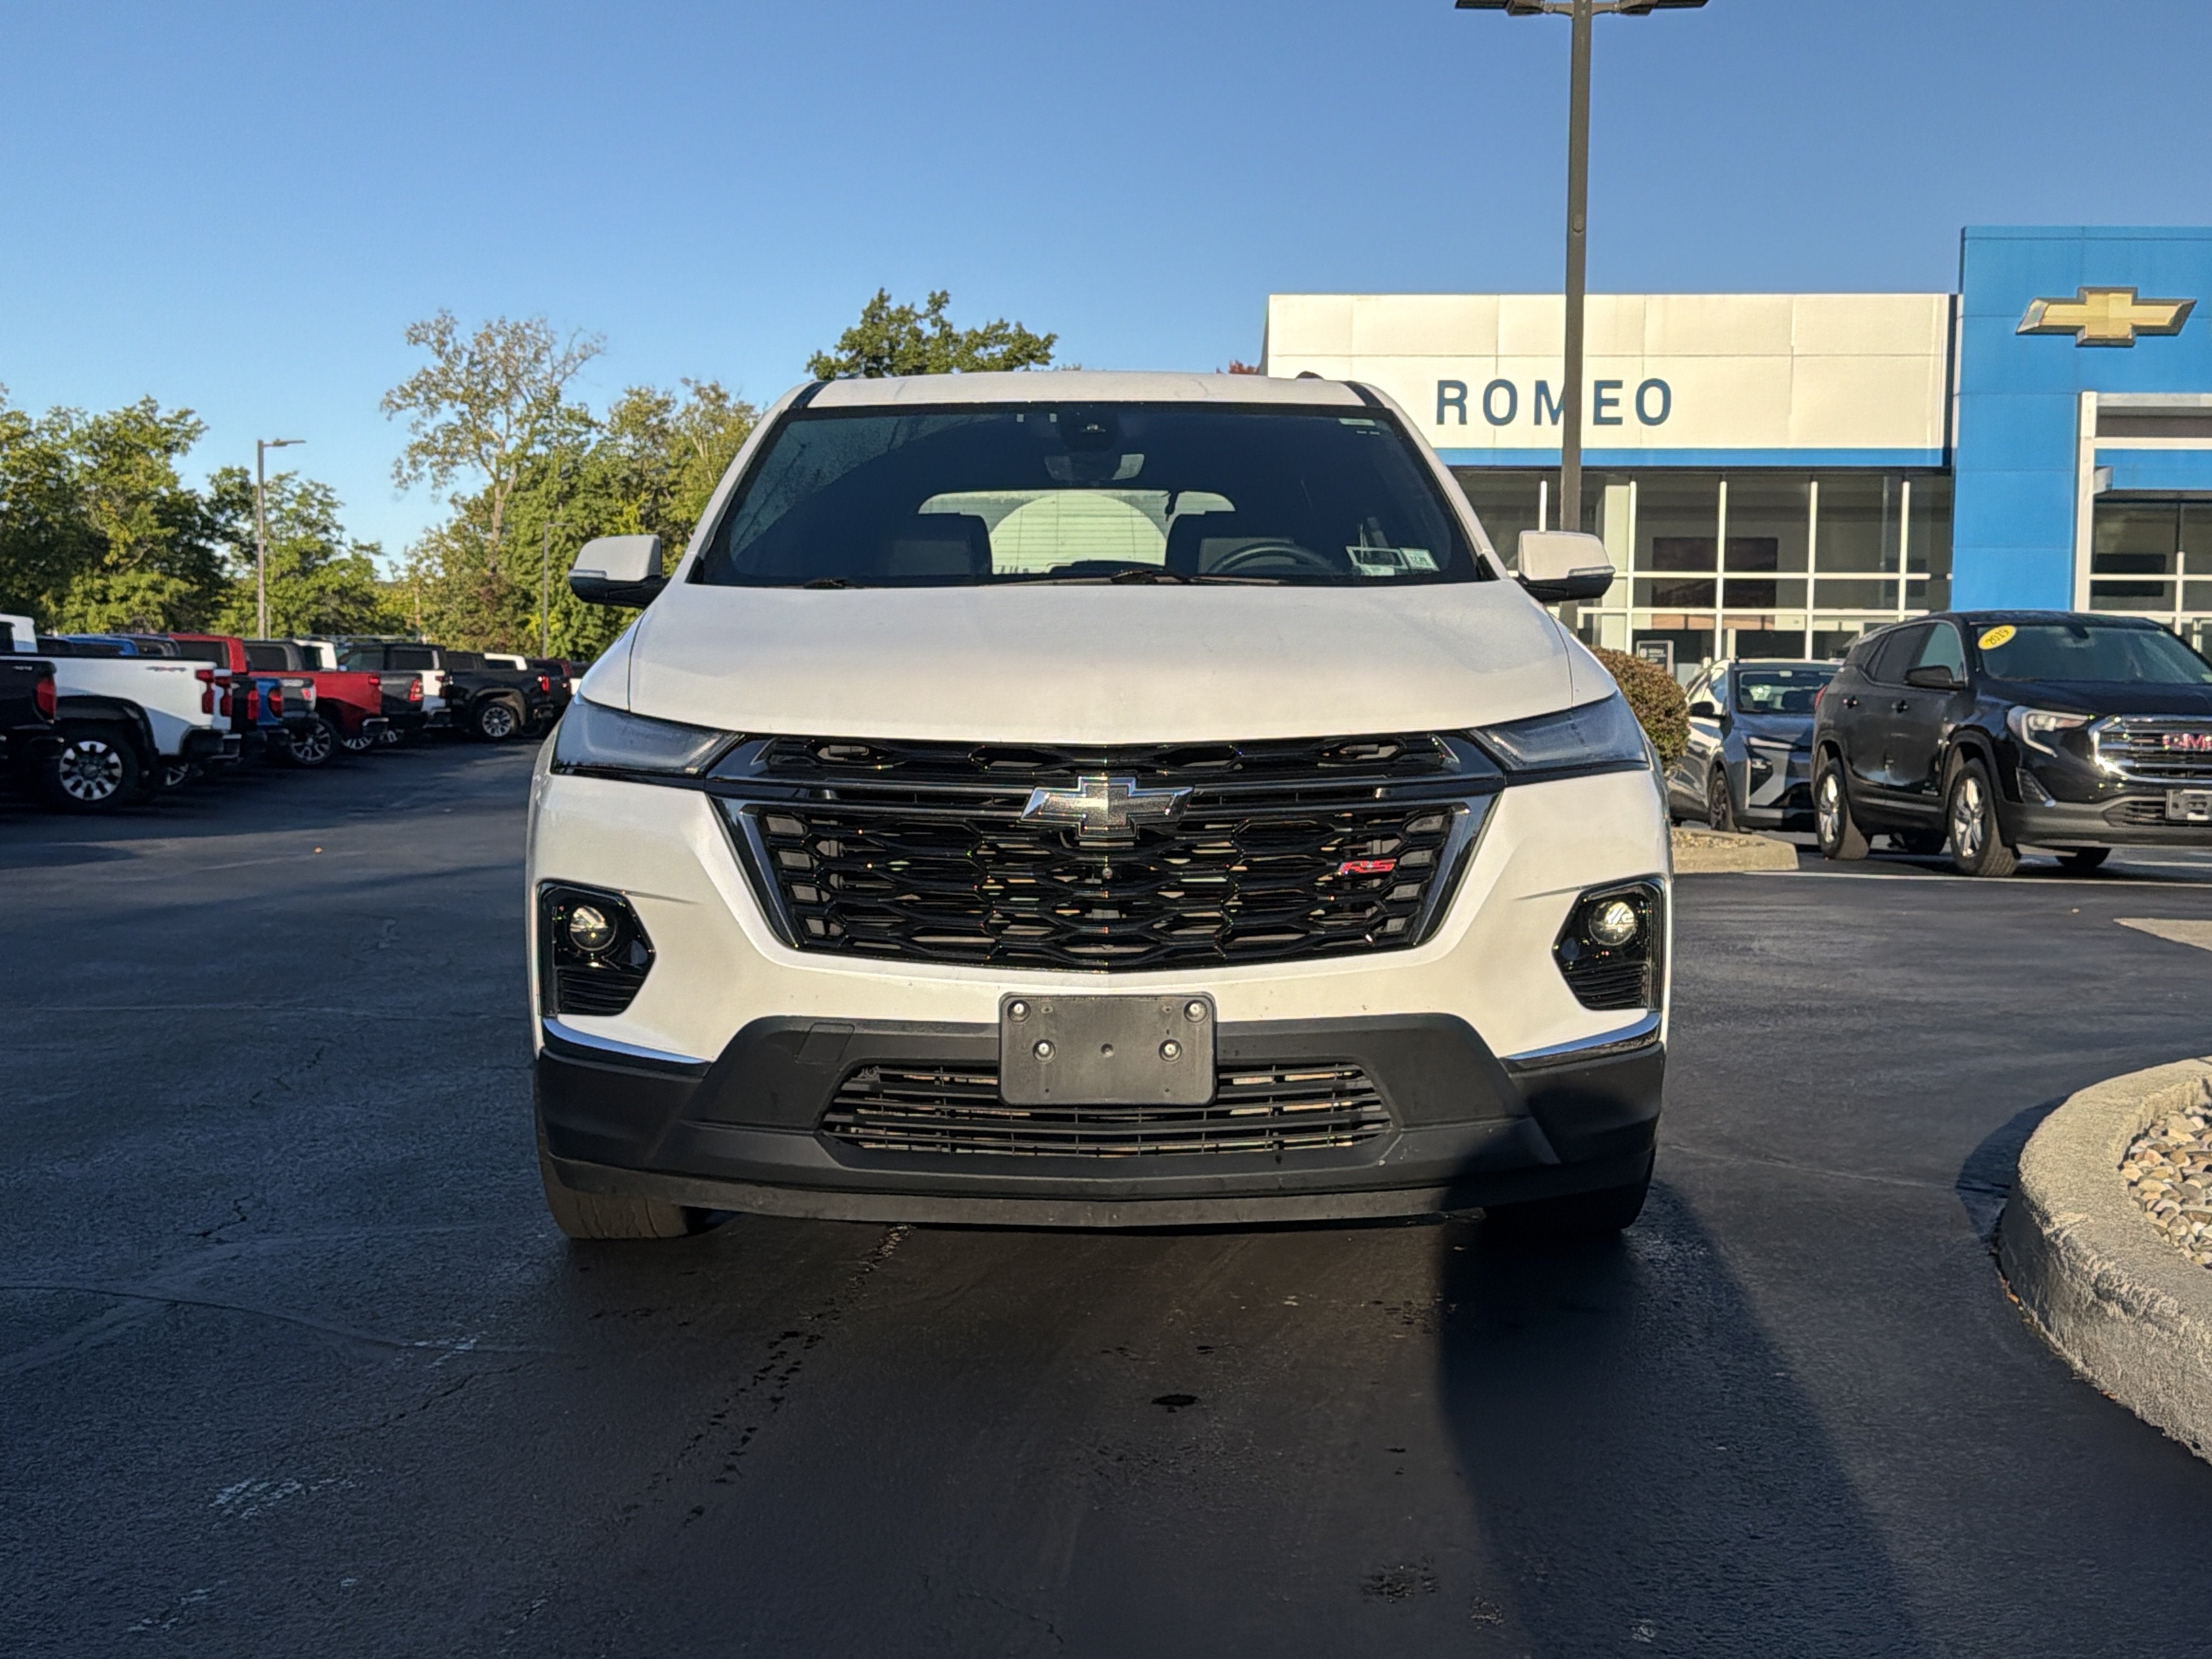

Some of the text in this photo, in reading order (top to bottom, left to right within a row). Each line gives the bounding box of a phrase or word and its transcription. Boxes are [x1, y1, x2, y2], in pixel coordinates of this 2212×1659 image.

[1436, 377, 1672, 426] ROMEO
[1984, 629, 2010, 646] 2019
[1338, 858, 1397, 874] RS
